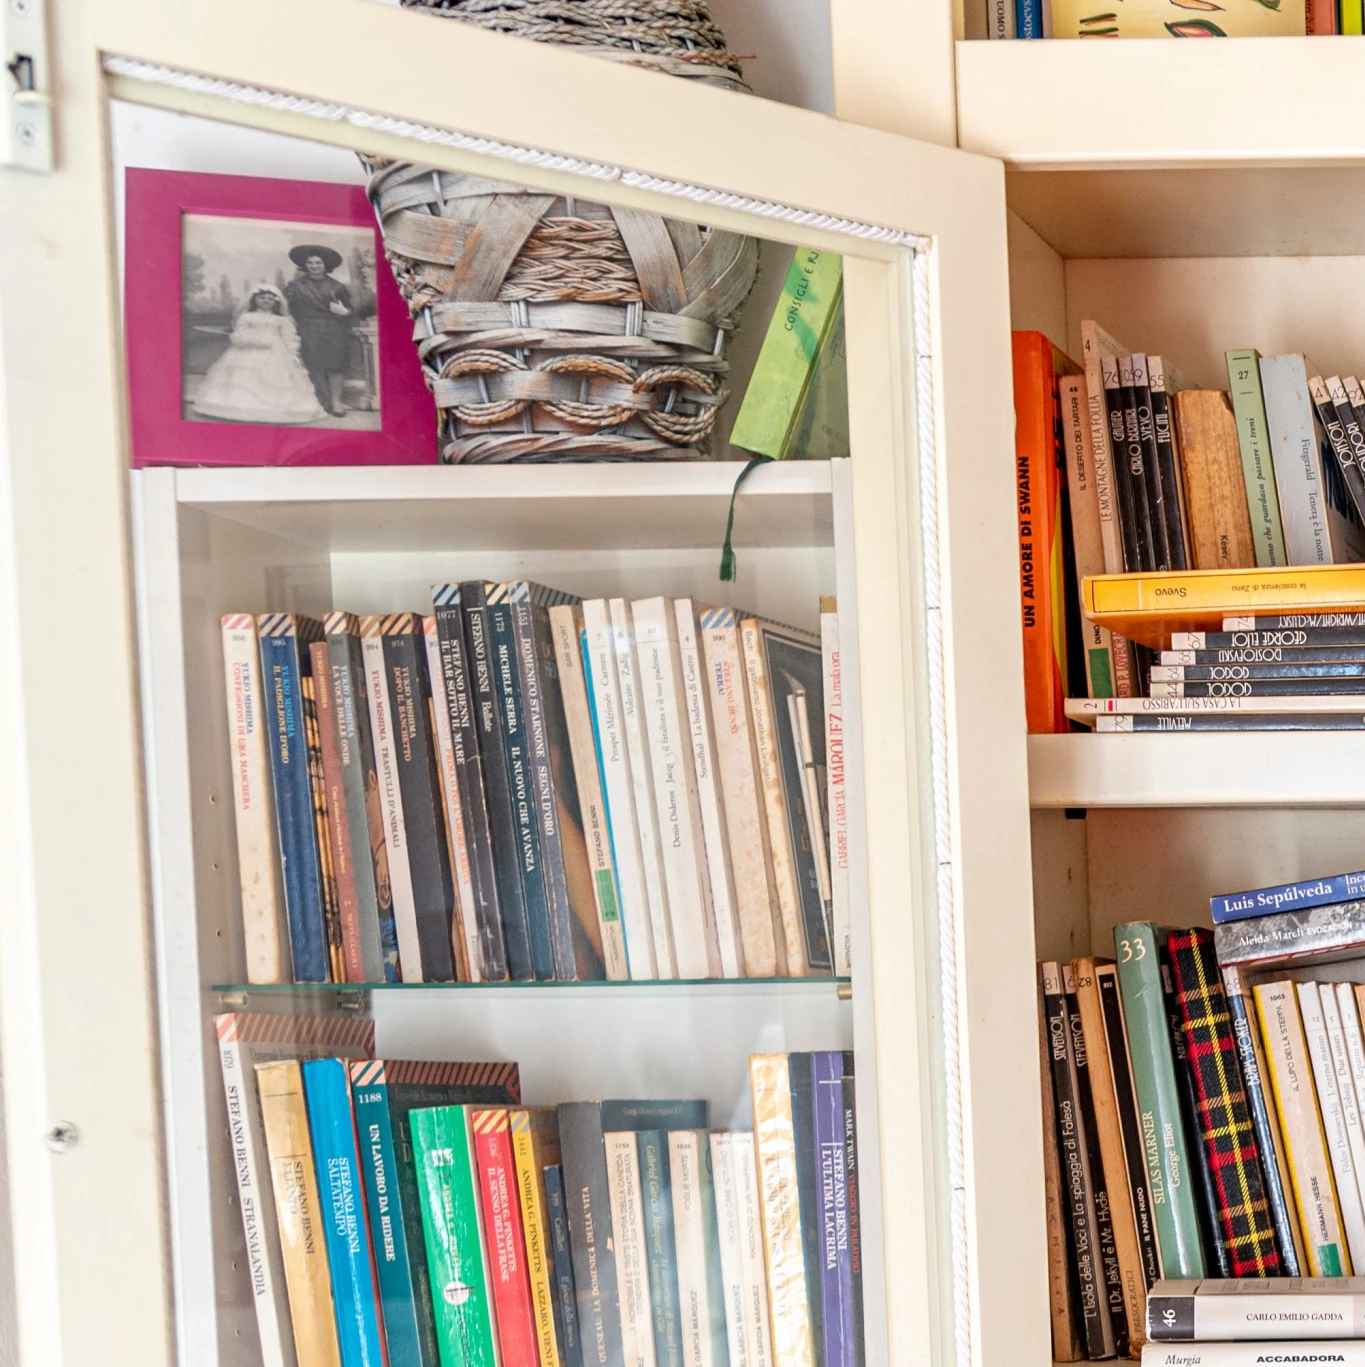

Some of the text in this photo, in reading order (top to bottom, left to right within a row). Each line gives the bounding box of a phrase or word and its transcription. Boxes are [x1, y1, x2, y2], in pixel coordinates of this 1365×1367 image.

[785, 278, 809, 331] CONSIGLI
[1238, 370, 1250, 380] 27
[1019, 456, 1036, 628] UN AMORE DI SWANN
[1154, 586, 1188, 599] Svevo
[499, 645, 518, 736] MICHELE SERRA
[832, 711, 846, 786] MÁRQUEZ
[1223, 882, 1332, 913] Luis Sepúlveda
[1120, 938, 1146, 961] 33
[1142, 1111, 1167, 1205] SILAS MARNER
[1163, 1124, 1181, 1190] George Eliot
[368, 1124, 396, 1262] UN LAVORO DA RIDERE
[1162, 1308, 1176, 1327] 46
[1246, 1312, 1343, 1322] CARLO EMILIO GADDA
[1165, 1353, 1201, 1367] Murgia
[1256, 1354, 1345, 1364] ACCABADORA
